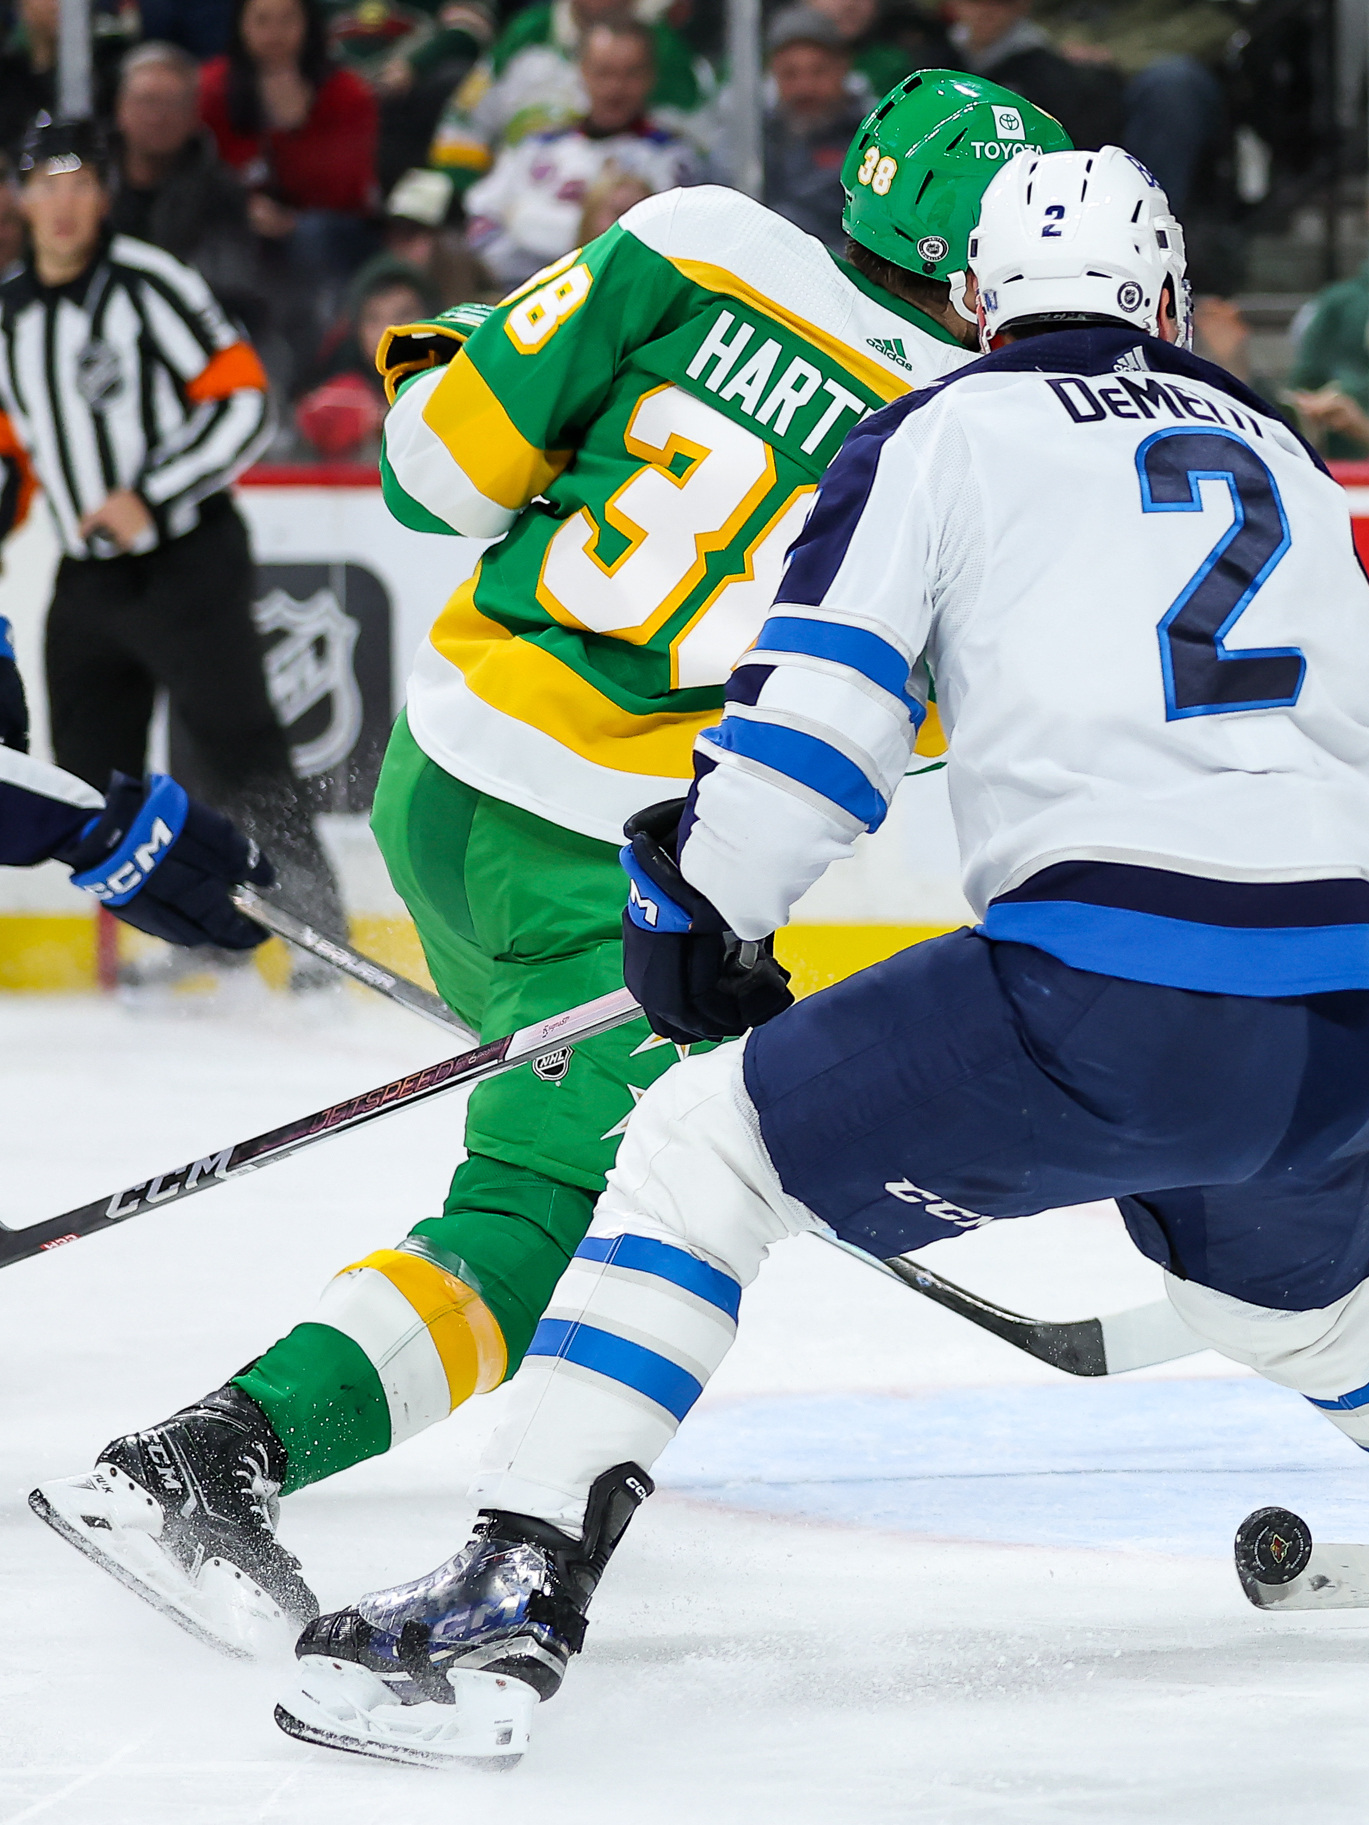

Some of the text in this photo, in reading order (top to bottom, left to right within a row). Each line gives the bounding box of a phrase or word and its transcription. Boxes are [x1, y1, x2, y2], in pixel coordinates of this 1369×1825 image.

[857, 145, 898, 196] 38
[1041, 204, 1066, 238] 2
[685, 309, 877, 468] HART
[866, 337, 913, 372] adidas
[1135, 426, 1307, 722] 2
[84, 816, 173, 900] CCM
[309, 1058, 456, 1133] JETSPEED
[539, 1052, 566, 1068] NHL
[105, 1145, 236, 1220] CCM
